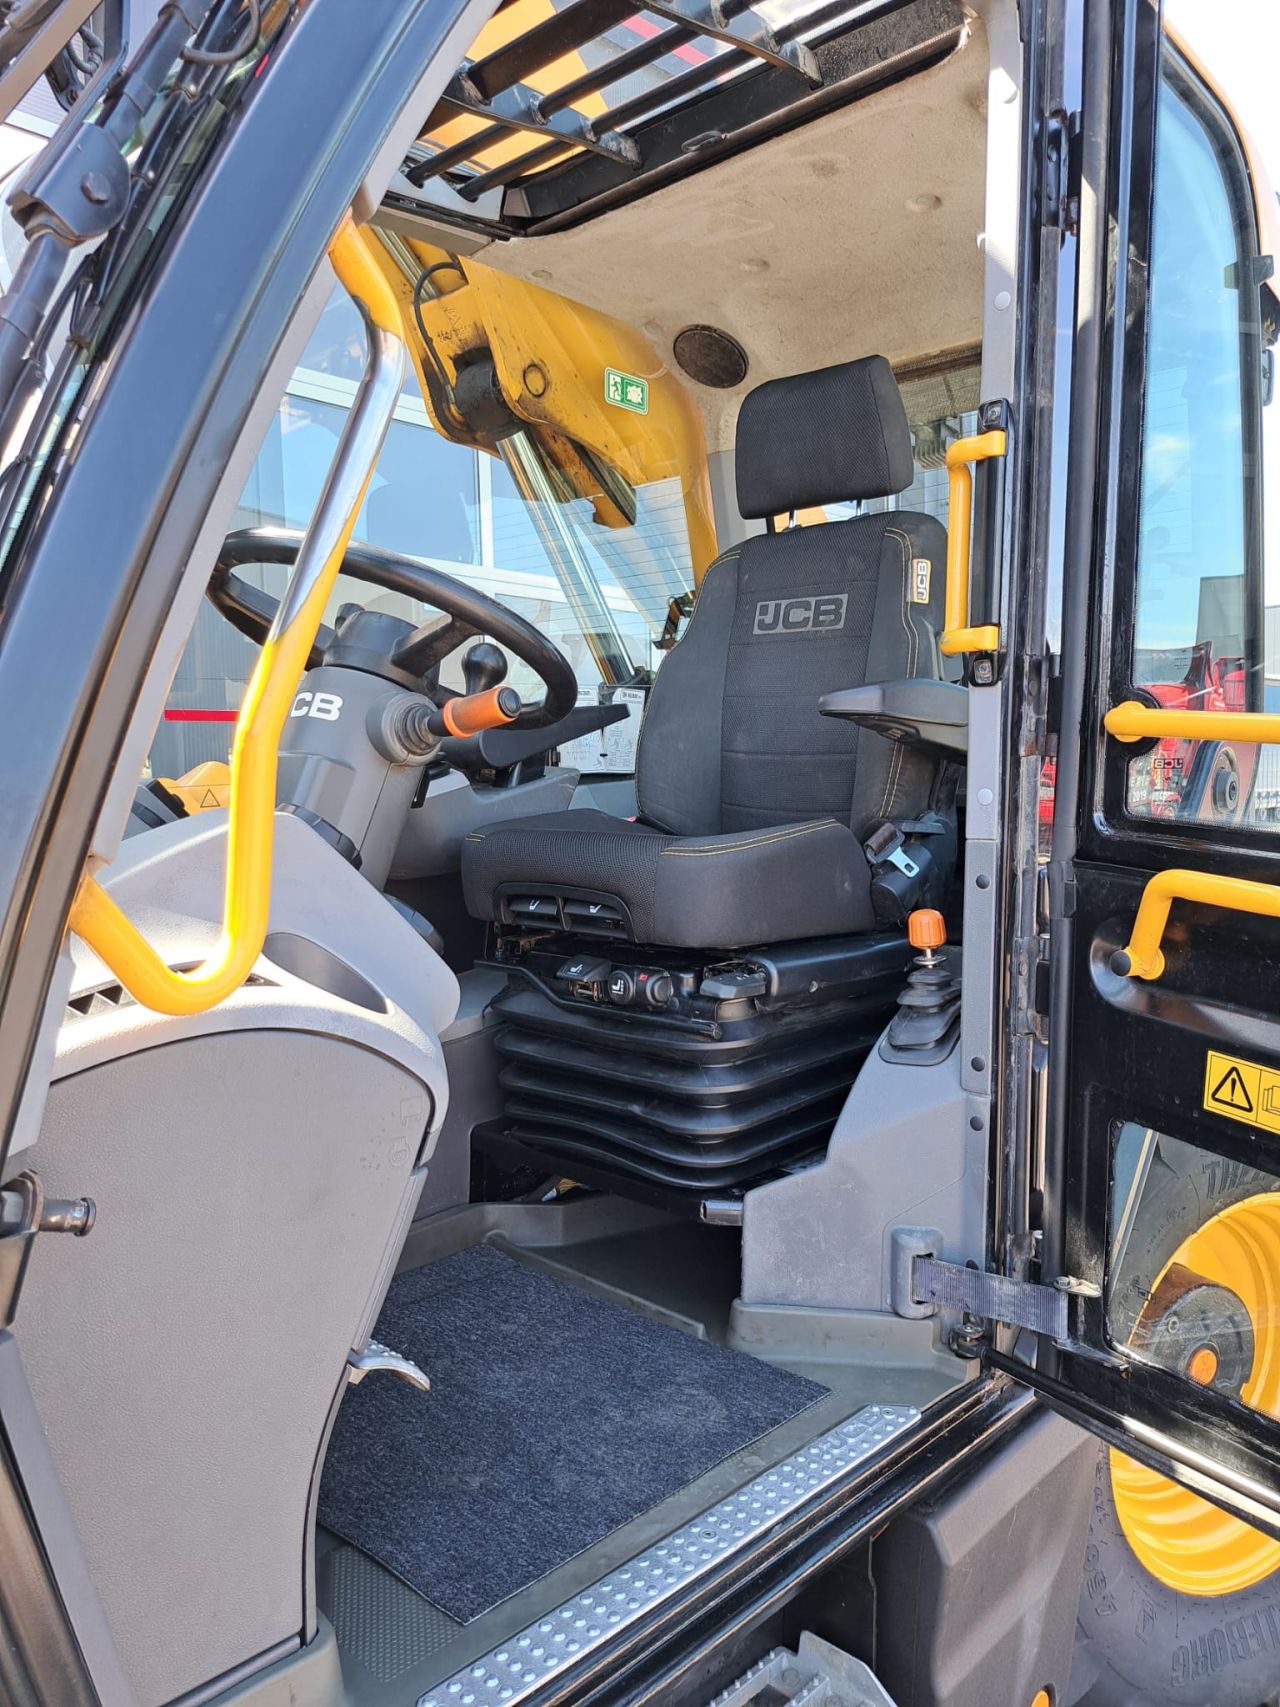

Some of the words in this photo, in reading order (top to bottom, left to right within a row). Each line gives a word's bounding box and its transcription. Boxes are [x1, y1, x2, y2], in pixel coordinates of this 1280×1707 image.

[917, 561, 927, 600] JCB
[754, 594, 847, 634] JCB
[290, 691, 343, 721] CB
